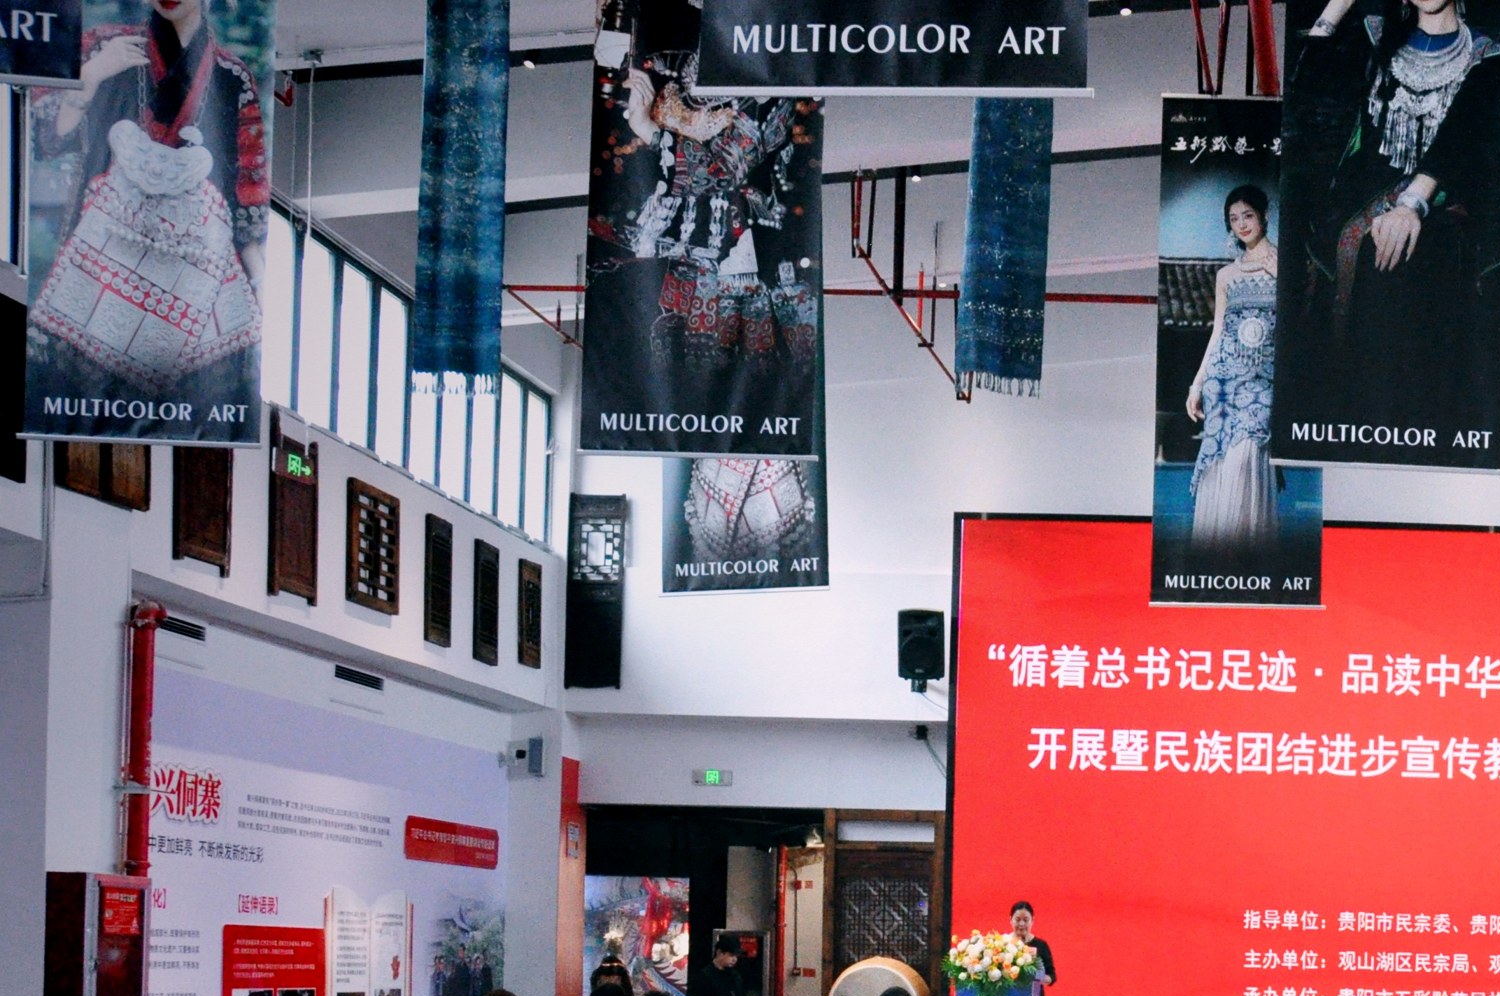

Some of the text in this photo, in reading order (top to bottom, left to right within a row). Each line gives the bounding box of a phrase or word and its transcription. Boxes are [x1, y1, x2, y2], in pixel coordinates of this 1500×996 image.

[0, 9, 58, 42] RT
[732, 23, 1067, 55] MULTICOLOR ART
[44, 396, 249, 423] MULTICOLOR ART
[600, 412, 801, 435] MULTICOLOR ART
[1291, 422, 1492, 449] MULTICOLOR ART
[675, 557, 820, 577] MULTICOLOR ART
[1164, 574, 1312, 591] MULTICOLOR ART
